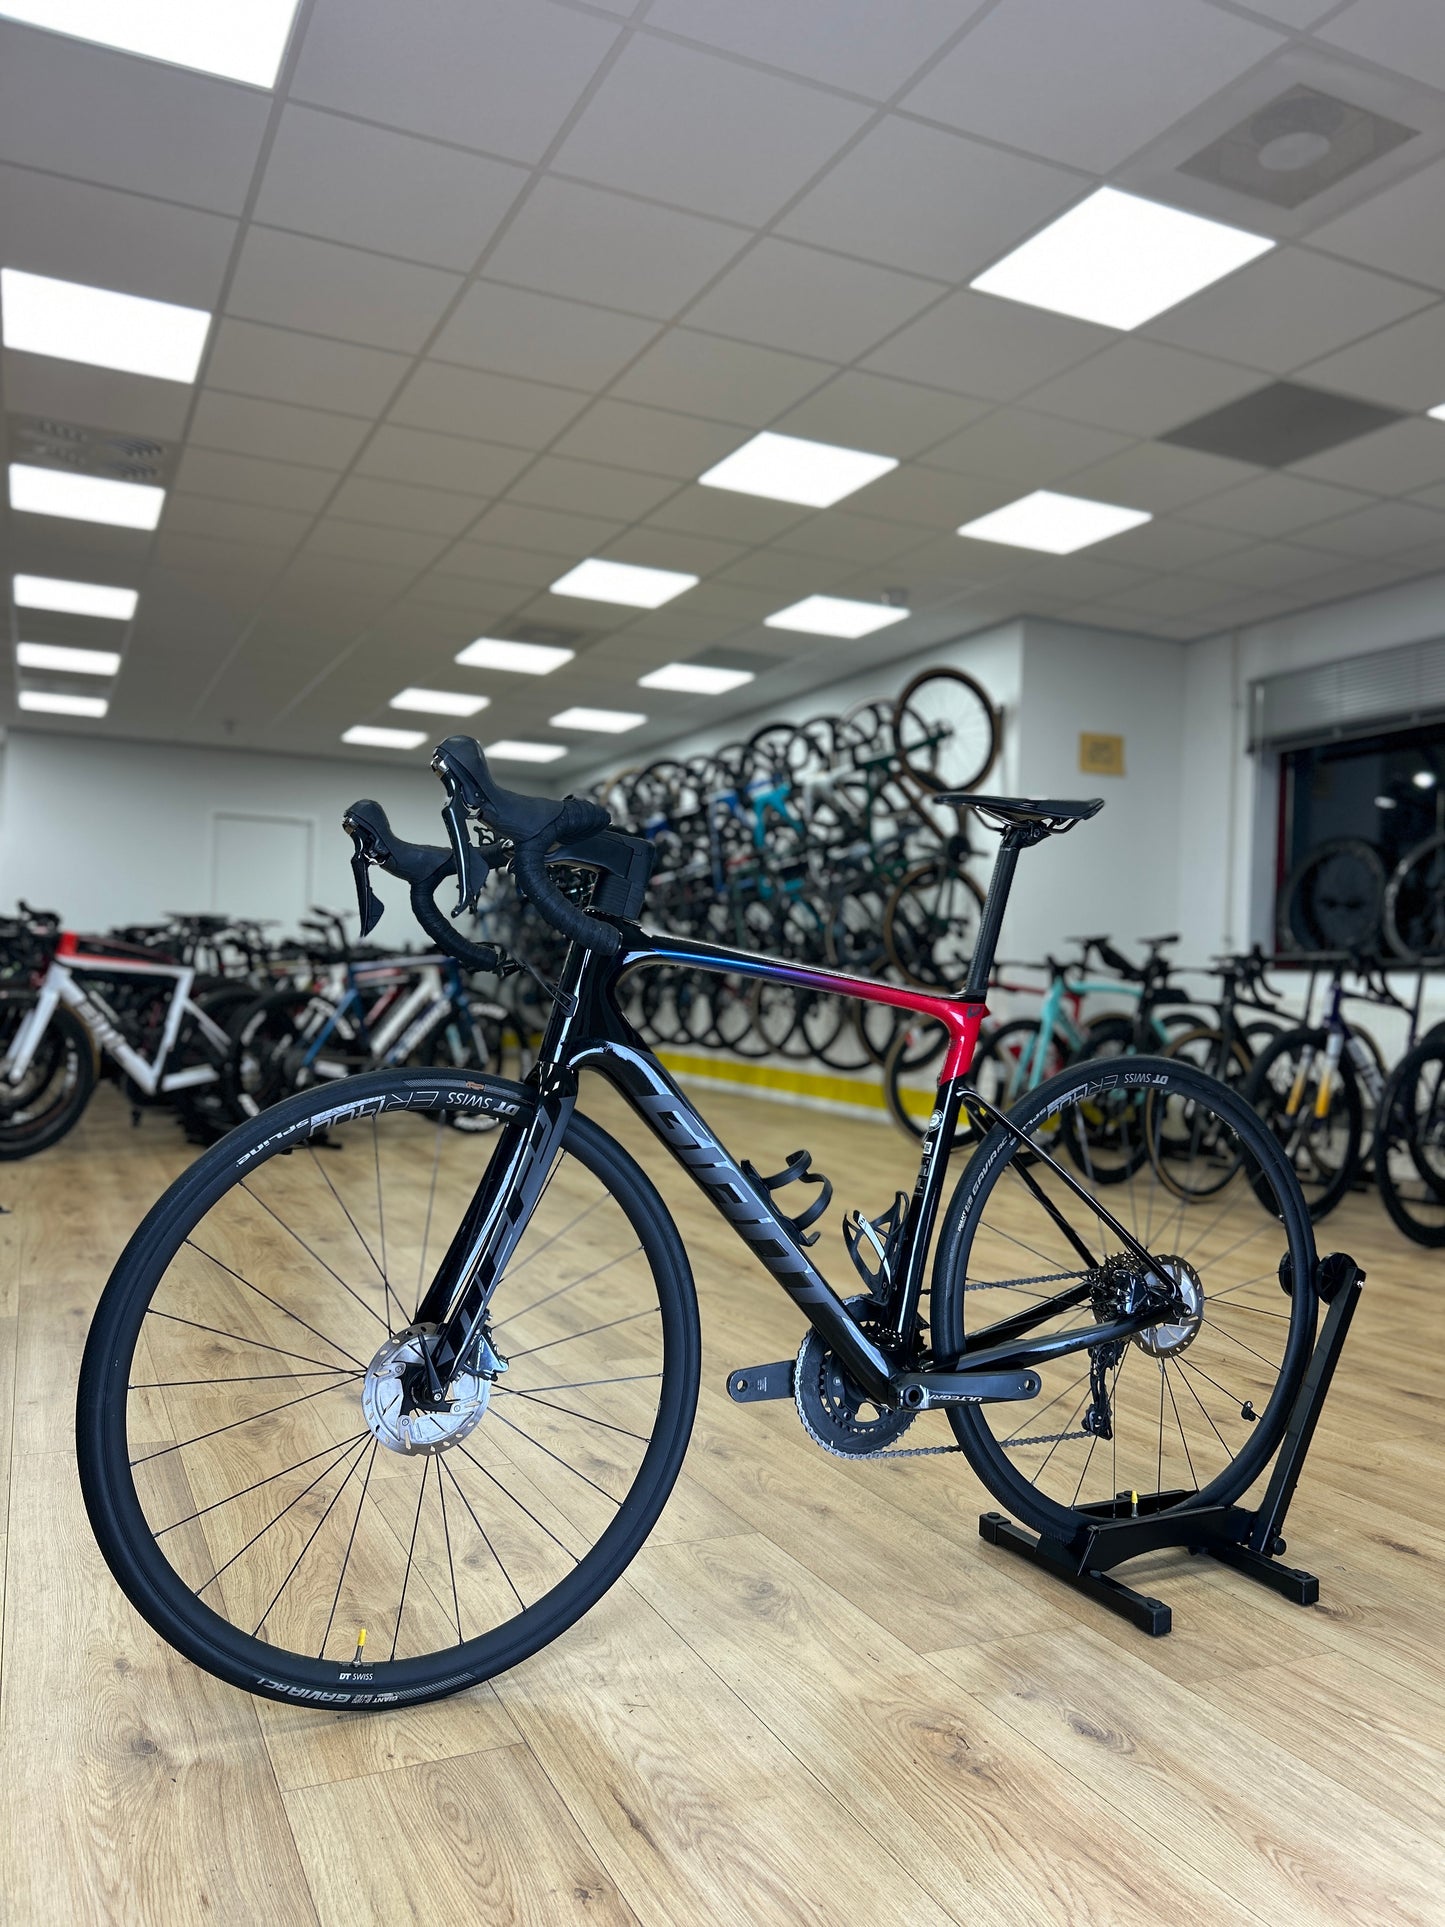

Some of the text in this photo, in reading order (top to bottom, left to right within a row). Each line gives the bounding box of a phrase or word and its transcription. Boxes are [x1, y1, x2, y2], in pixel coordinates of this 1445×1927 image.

[1124, 1073, 1152, 1084] SWISS
[1152, 1074, 1169, 1085] DT
[446, 1092, 493, 1109] SWISS
[491, 1101, 520, 1117] DT
[972, 1150, 997, 1197] GAVIA
[634, 1093, 851, 1320] GIANT
[339, 1672, 373, 1681] DT SWISS
[287, 1688, 352, 1704] GAVIA
[372, 1694, 399, 1704] GIANT
